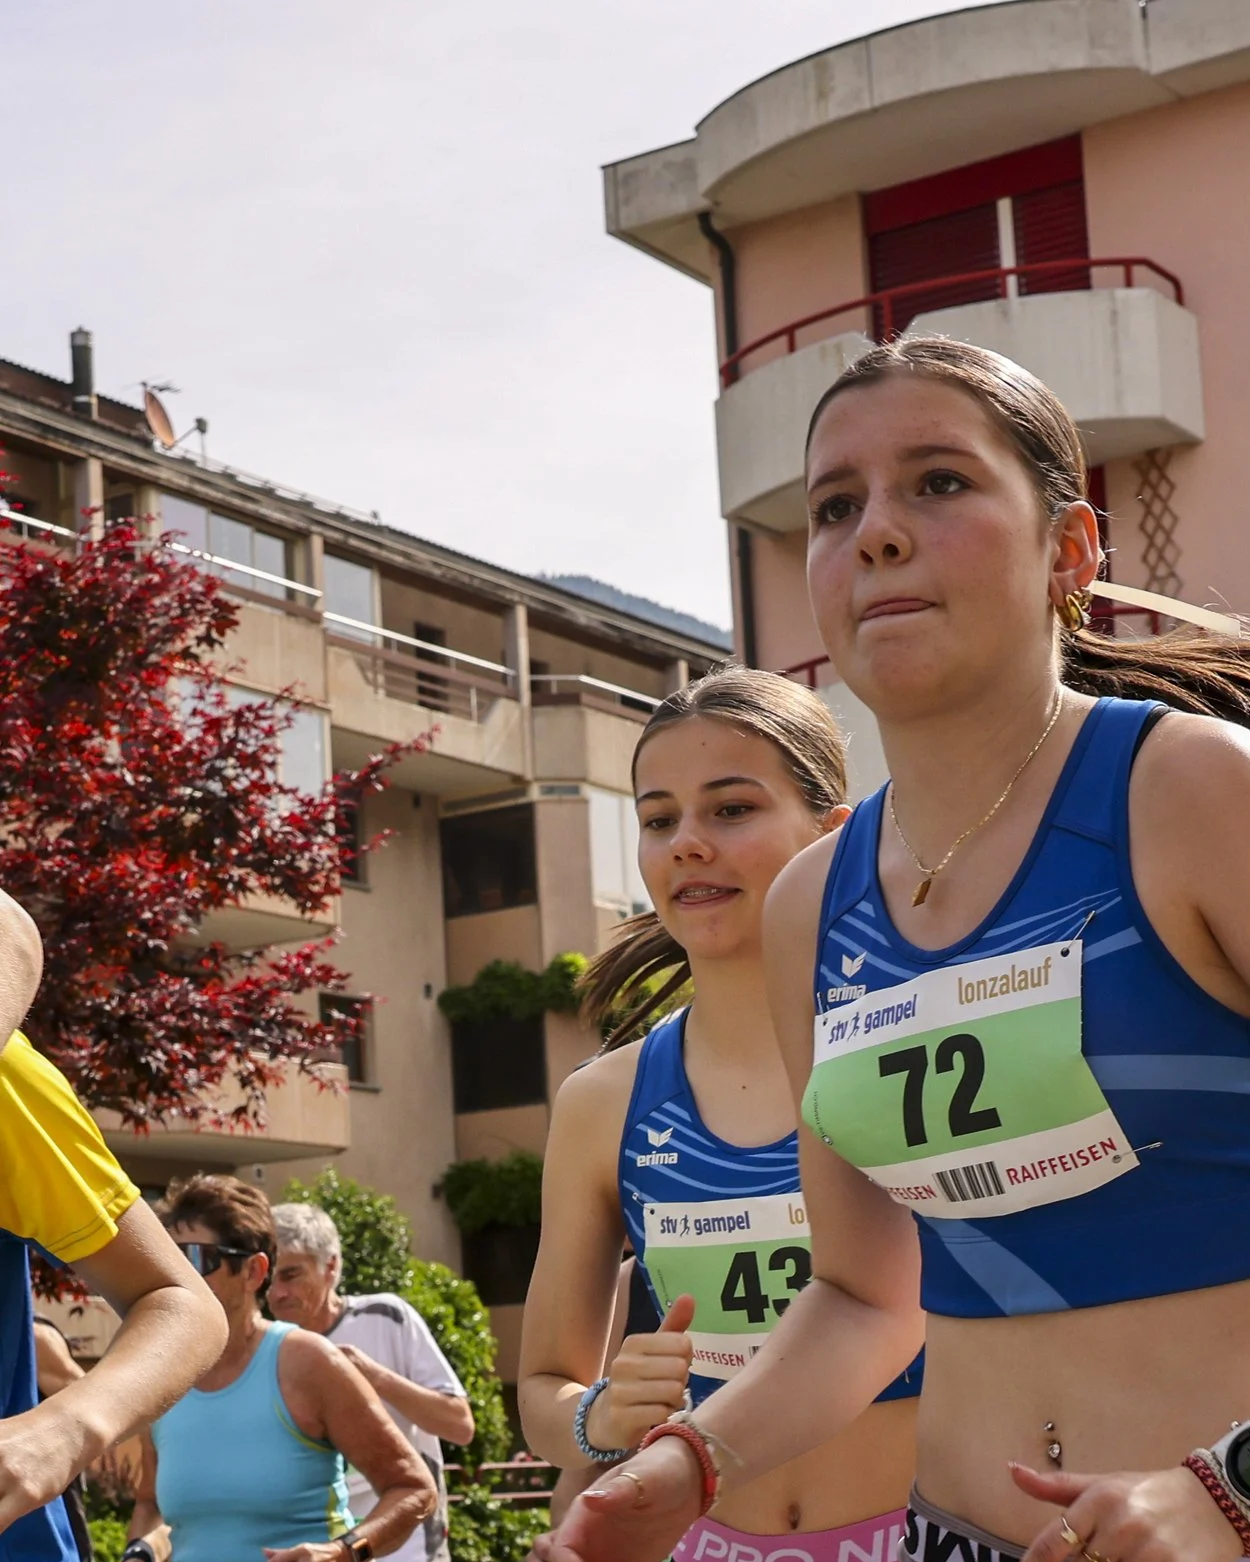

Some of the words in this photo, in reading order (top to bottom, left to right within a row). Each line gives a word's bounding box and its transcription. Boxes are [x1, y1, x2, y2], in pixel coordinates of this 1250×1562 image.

[827, 982, 867, 1003] erima
[829, 1019, 849, 1044] stv
[863, 993, 918, 1035] gampel
[957, 959, 1052, 1006] lonzalauf
[878, 1033, 1003, 1148] 72
[636, 1151, 679, 1168] erima
[1005, 1137, 1118, 1186] RAIFFEISEN
[660, 1215, 678, 1234] stv
[694, 1210, 751, 1235] gampel
[720, 1246, 812, 1323] 43
[693, 1349, 746, 1367] AIFFEISEN
